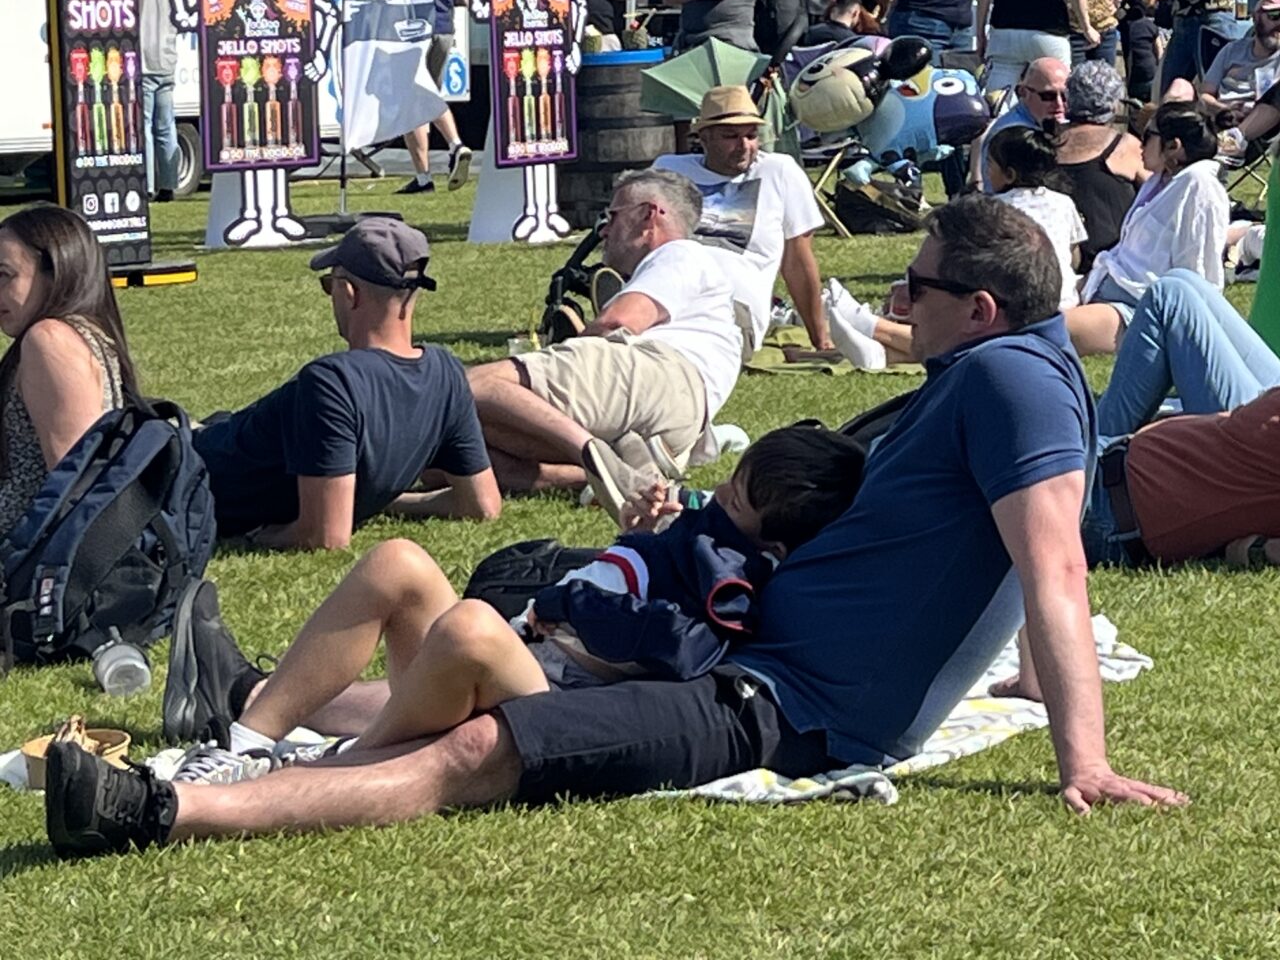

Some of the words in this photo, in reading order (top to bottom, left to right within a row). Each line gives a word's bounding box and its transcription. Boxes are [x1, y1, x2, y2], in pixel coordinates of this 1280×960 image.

[68, 0, 136, 30] SHOTS
[217, 40, 258, 55] JELLO
[260, 38, 301, 53] SHOTS
[504, 31, 533, 47] JELLO
[534, 29, 563, 45] SHOTS
